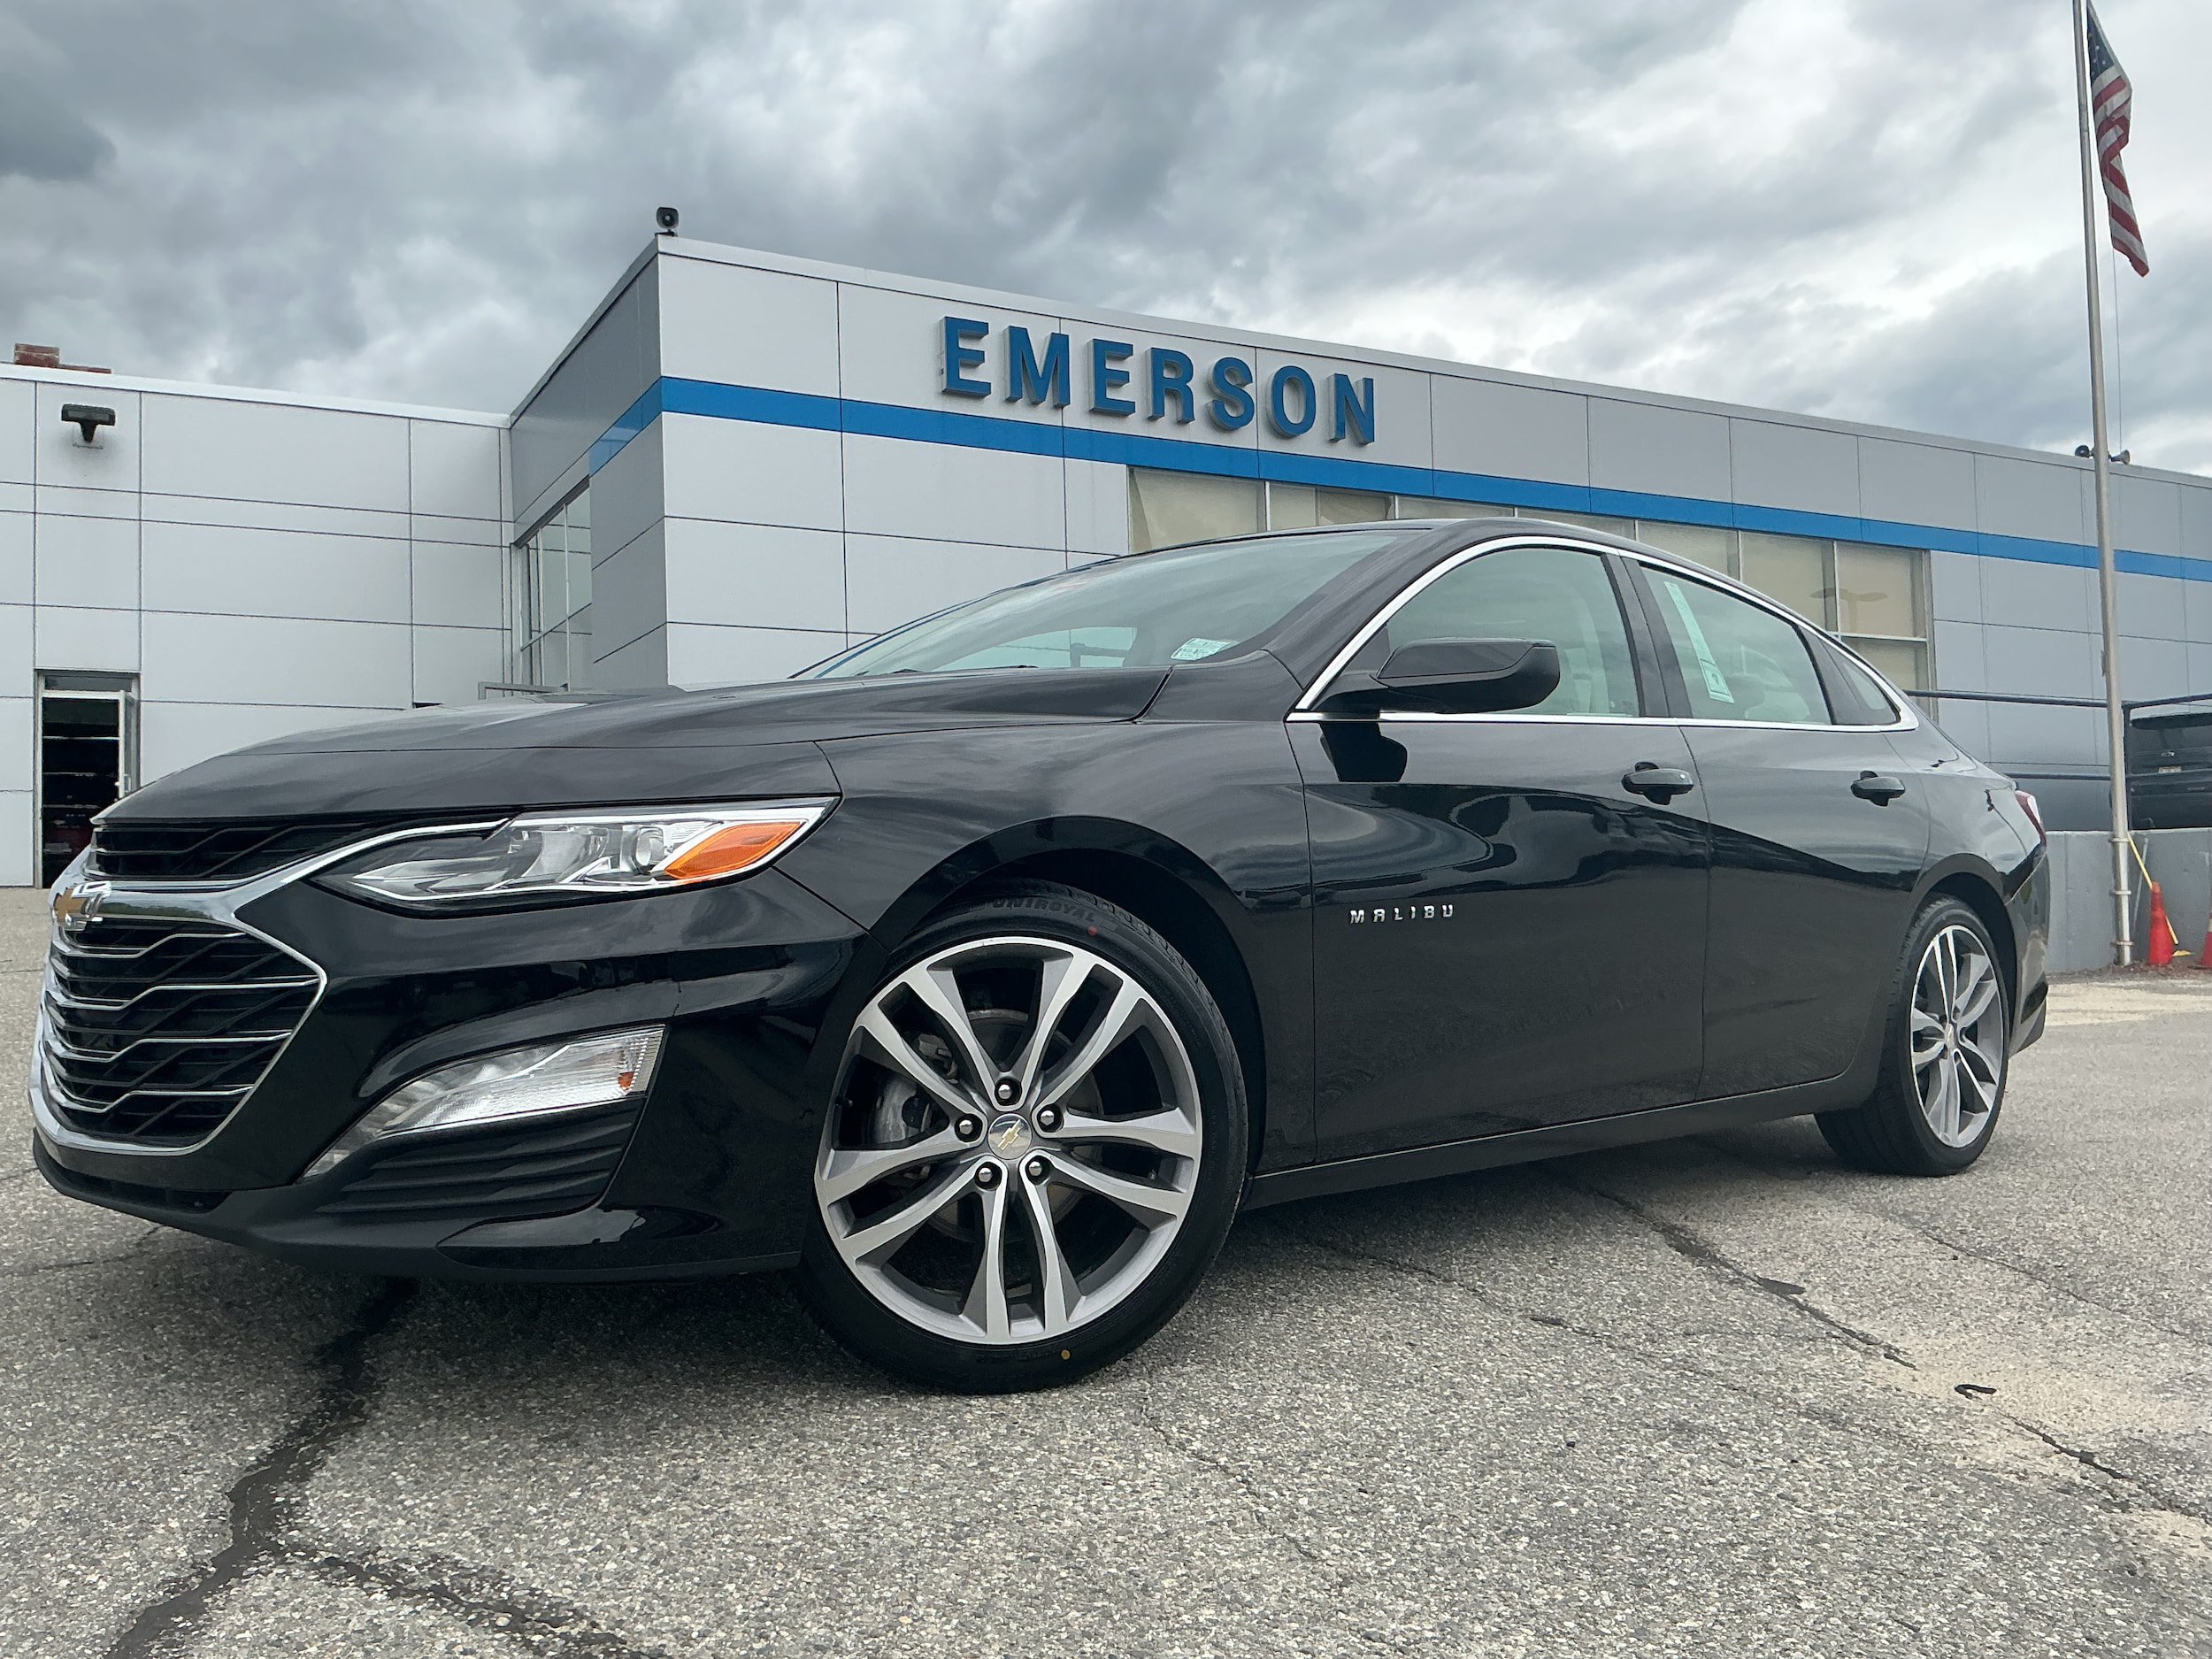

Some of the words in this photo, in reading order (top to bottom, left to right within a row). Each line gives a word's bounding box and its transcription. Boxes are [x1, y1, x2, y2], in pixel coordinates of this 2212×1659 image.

[941, 316, 1375, 445] EMERSON
[992, 897, 1095, 923] UNIROYAL
[1349, 904, 1454, 925] MALIBU
